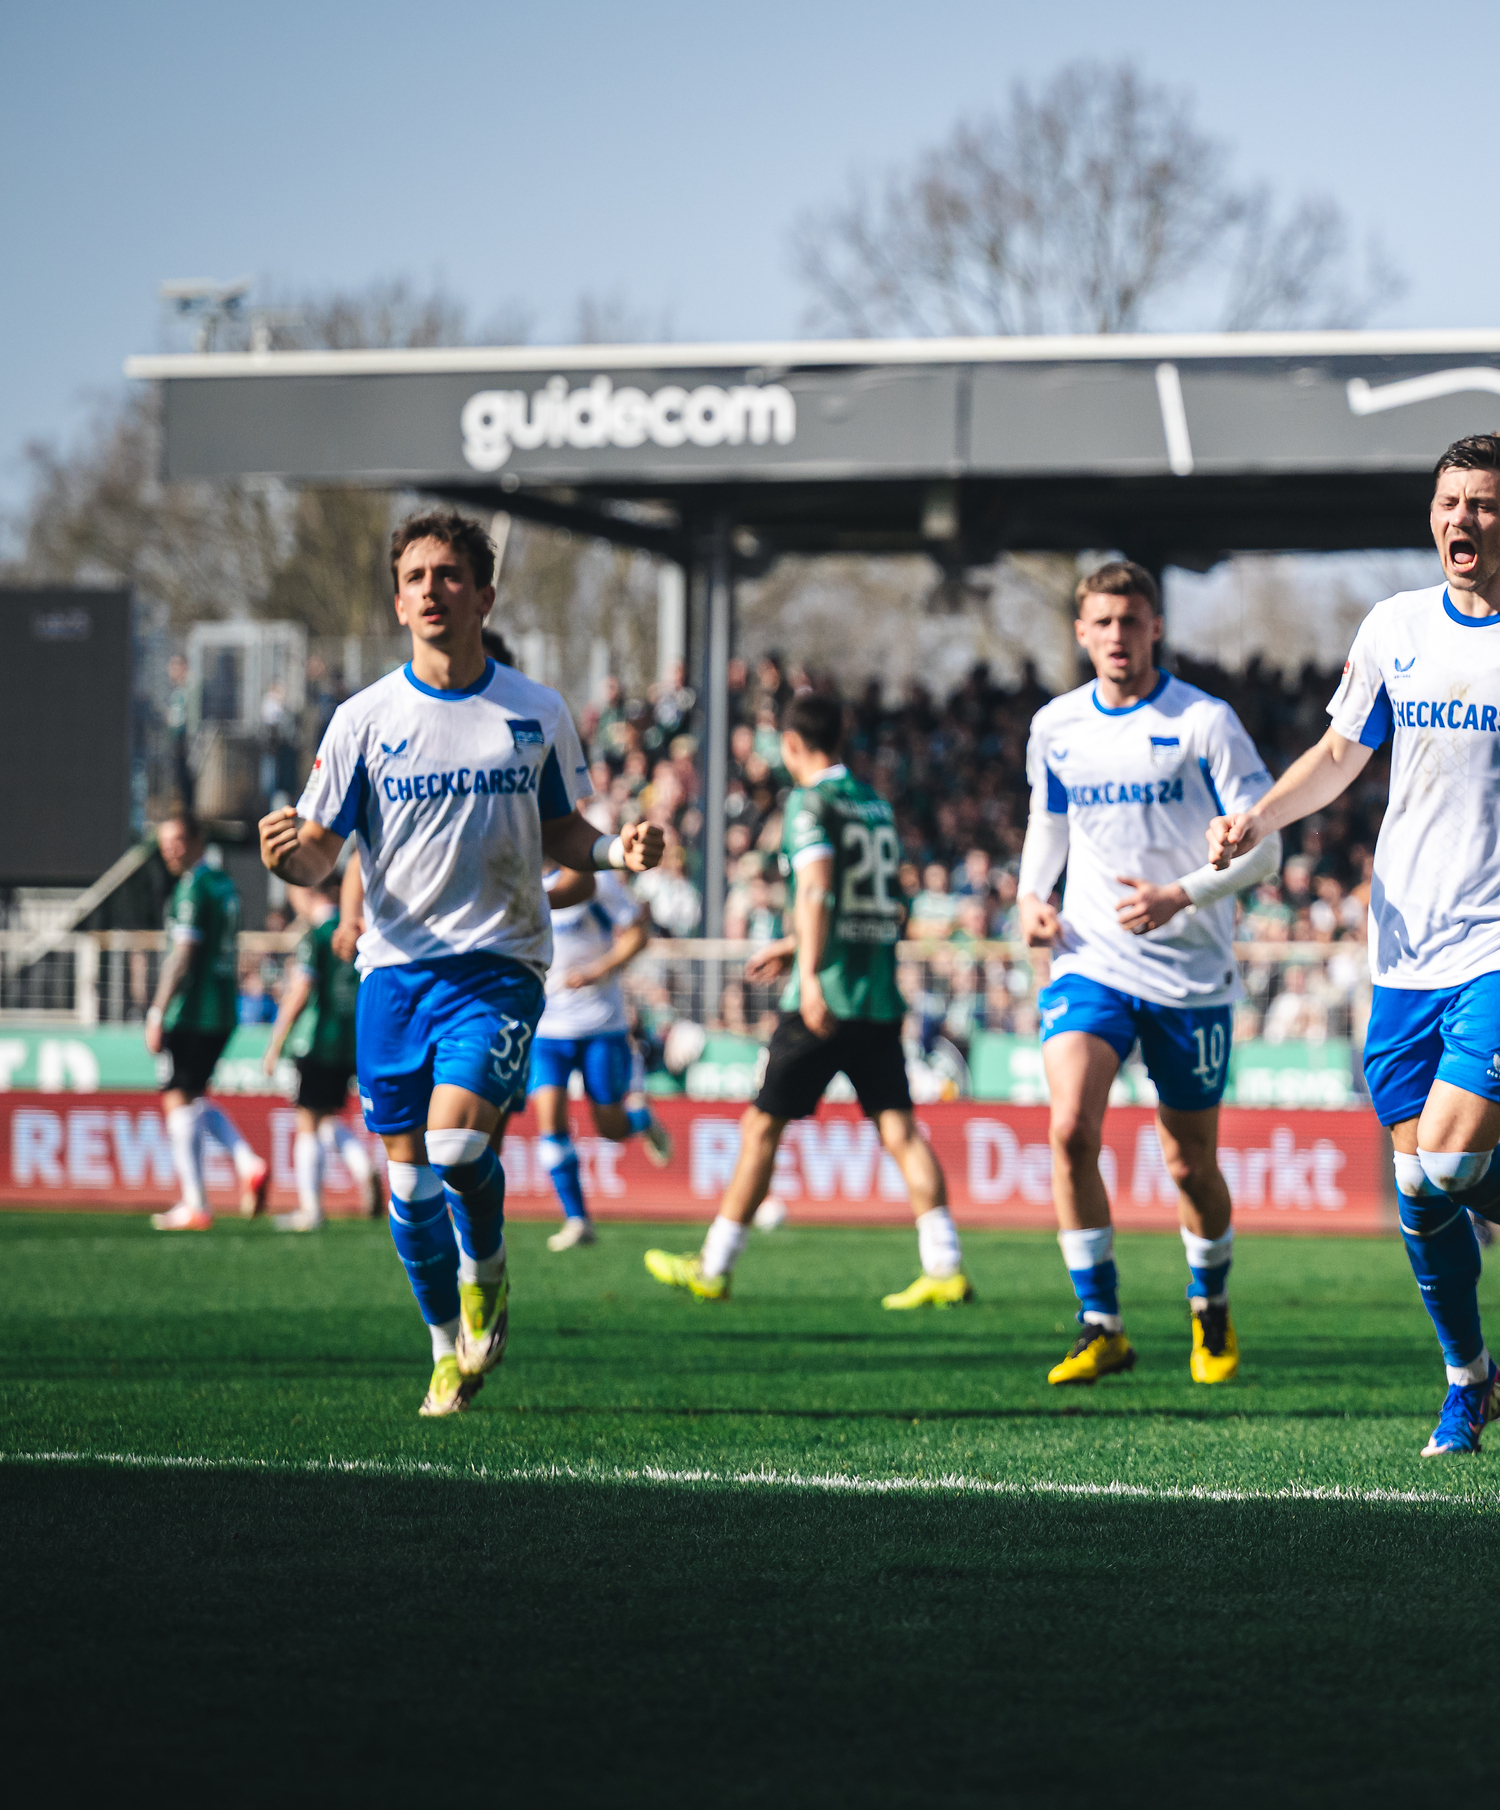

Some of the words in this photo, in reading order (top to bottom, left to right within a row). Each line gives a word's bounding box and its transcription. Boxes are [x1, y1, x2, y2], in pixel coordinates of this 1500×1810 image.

[461, 374, 796, 472] guidecom
[383, 765, 537, 802] CHECKCARS24
[490, 1013, 532, 1071] 33
[1192, 1023, 1225, 1076] 10
